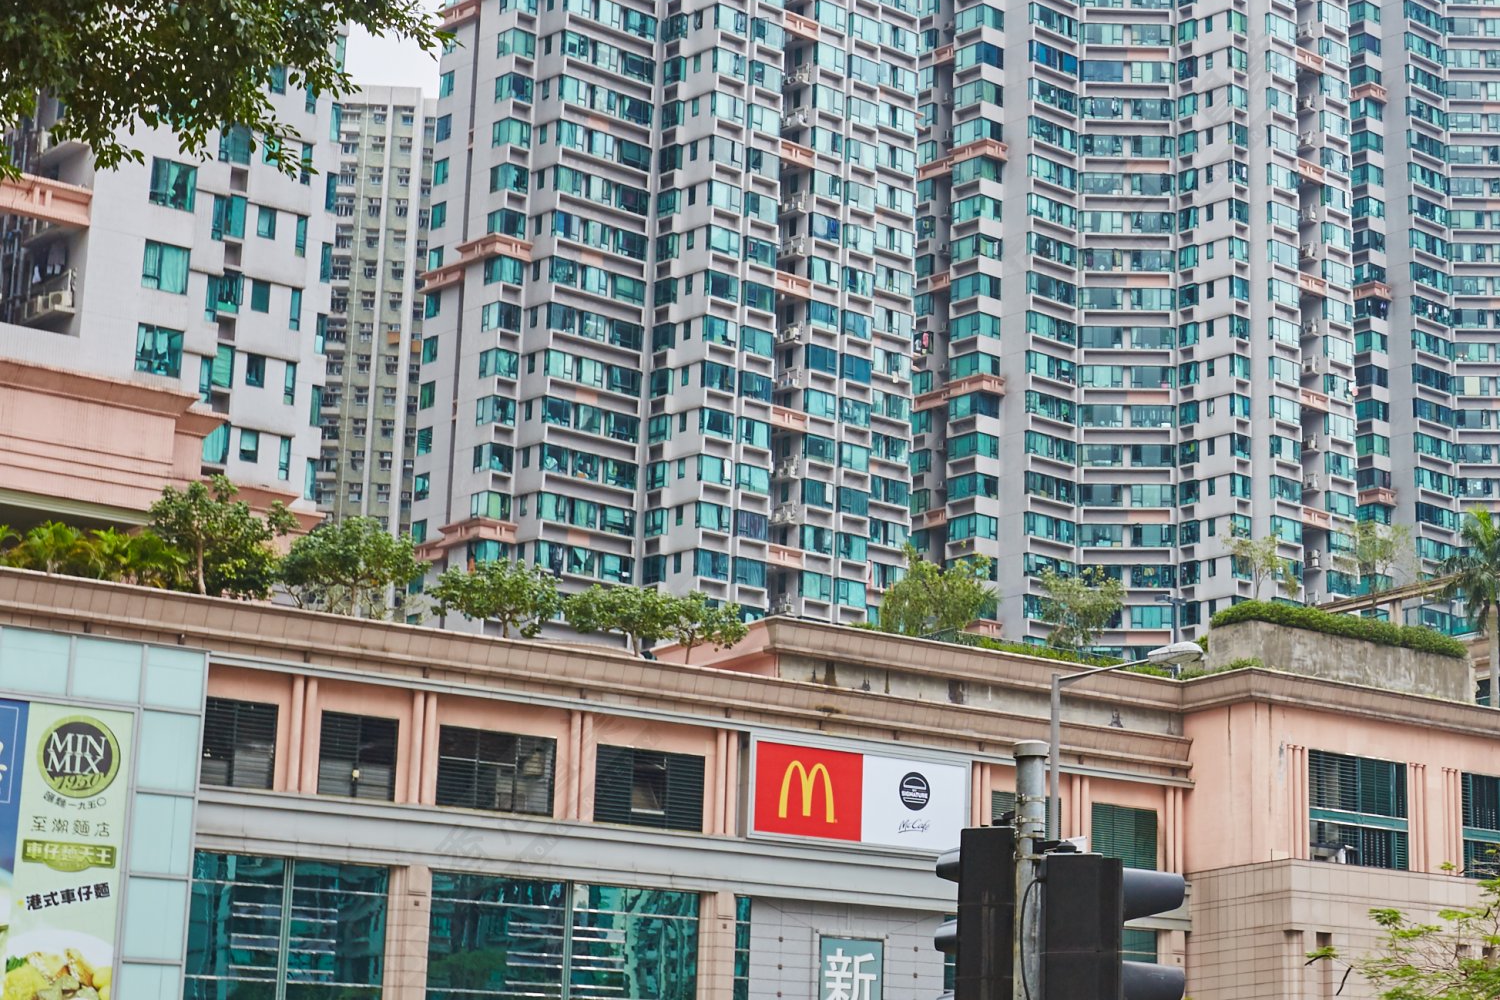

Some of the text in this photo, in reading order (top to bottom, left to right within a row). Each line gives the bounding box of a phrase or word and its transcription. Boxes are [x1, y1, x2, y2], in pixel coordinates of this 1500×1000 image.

[47, 731, 107, 758] MIN
[46, 752, 104, 775] MIX
[26, 881, 111, 911] 港式車仔麵
[825, 948, 877, 1000] 新
